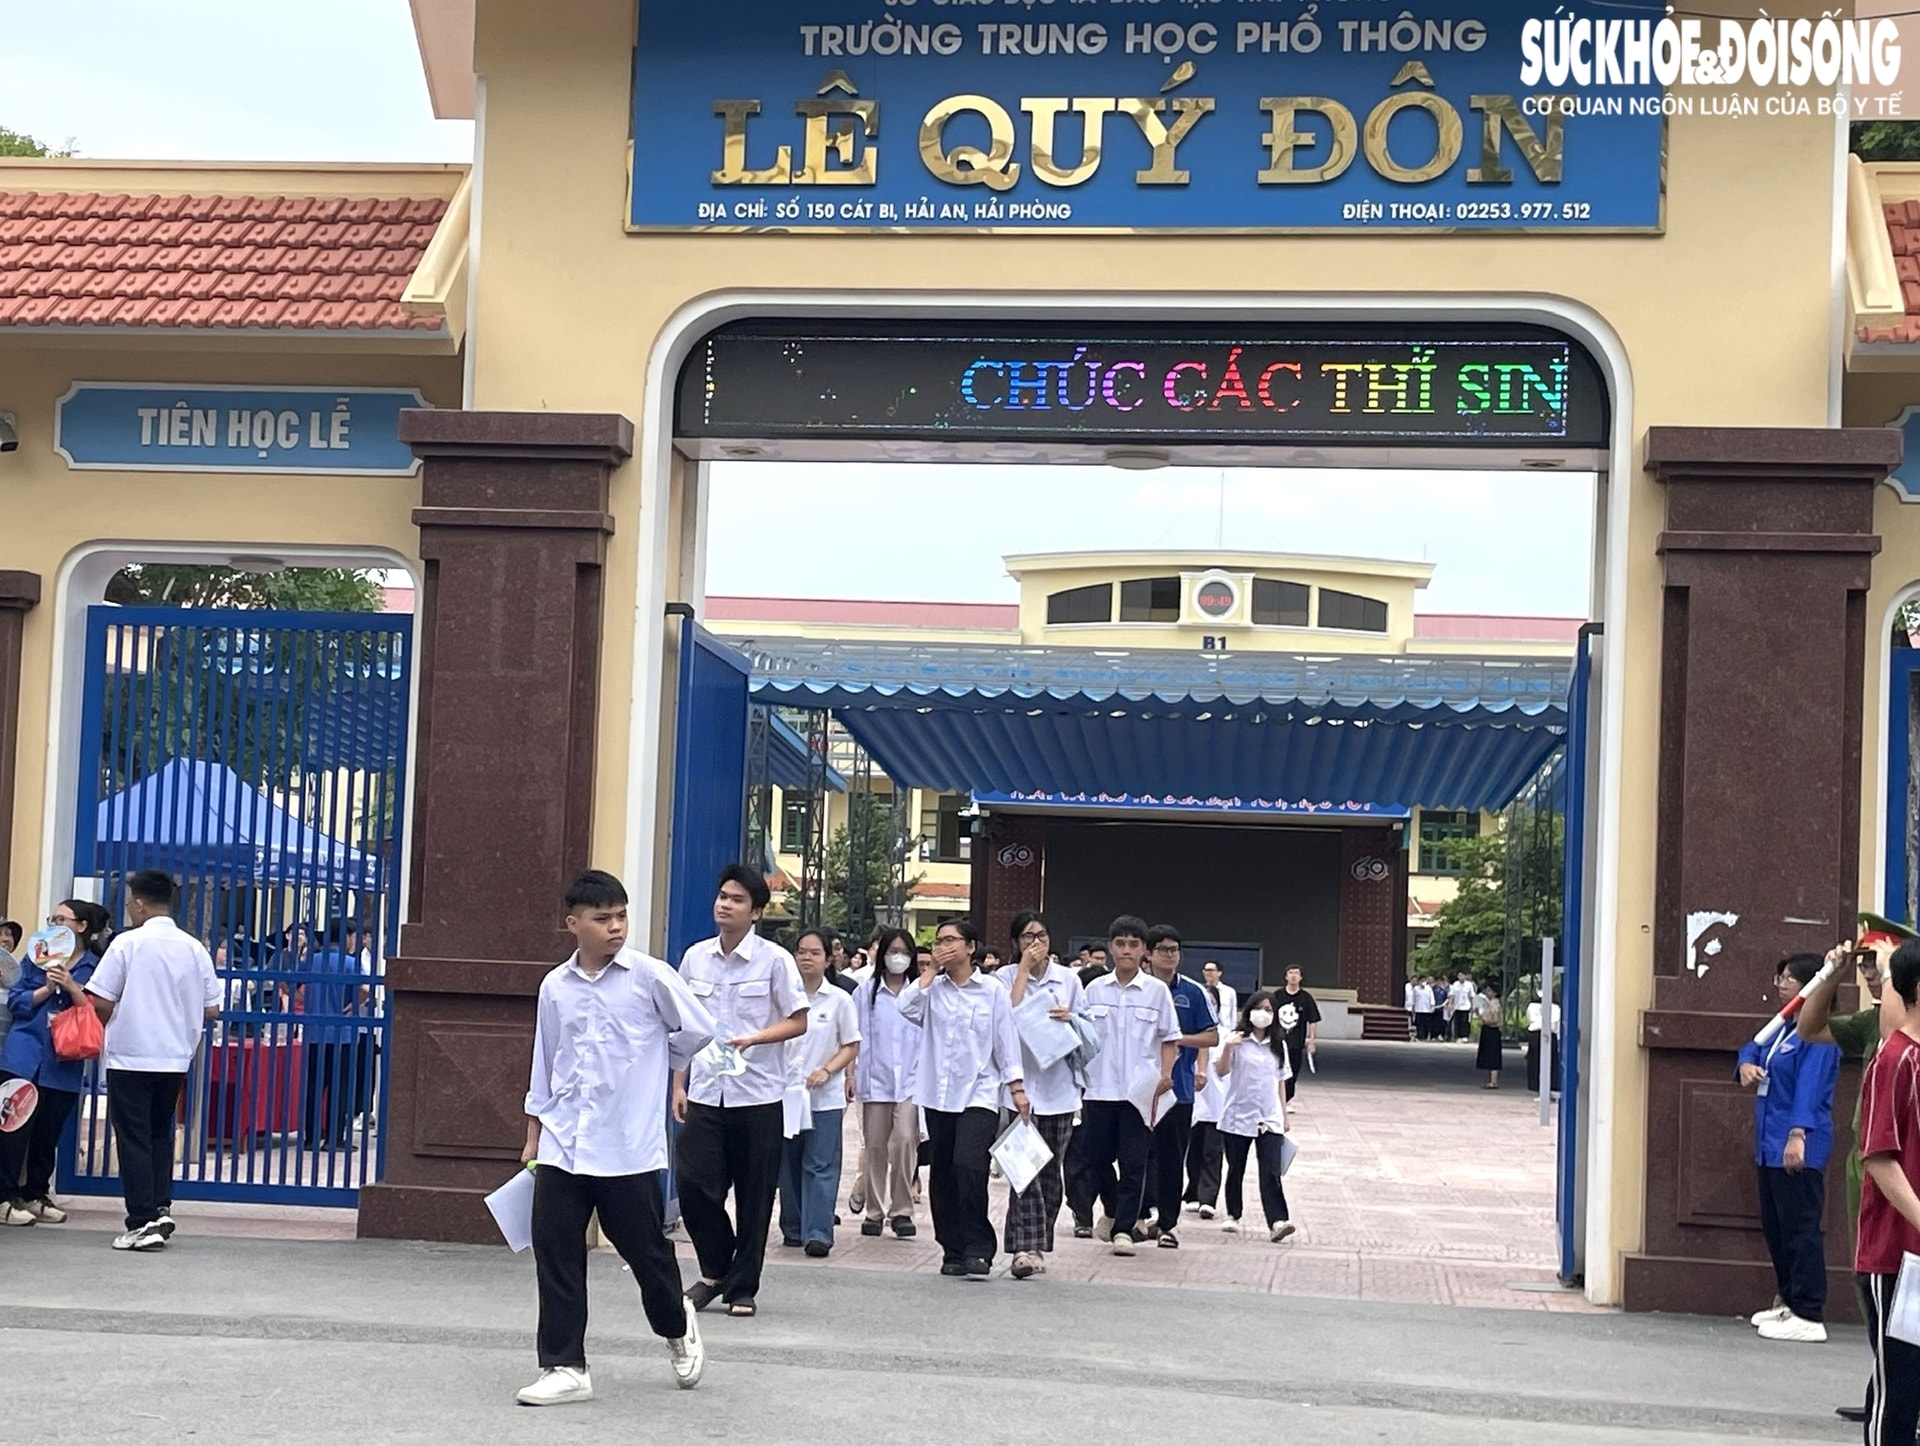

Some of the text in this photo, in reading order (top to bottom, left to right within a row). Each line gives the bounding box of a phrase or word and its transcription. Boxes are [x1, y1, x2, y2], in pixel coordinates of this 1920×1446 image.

[801, 4, 1487, 64] TRƯỜNG TRUNG HỌC PHỔ THÔNG
[711, 60, 1577, 191] LÊ QUÝ ĐÔN
[698, 195, 1072, 222] ĐỊA CHỈ: SỐ 150 CÁT BI, HẢI AN, HẢI PHÒNG
[1342, 199, 1383, 223] ĐIỆN
[1390, 203, 1451, 223] THOẠI:
[961, 346, 1146, 411] CHÚC
[1164, 347, 1302, 412] CÁC
[1456, 364, 1568, 414] SIN
[138, 397, 351, 459] TIÊN HỌC LỄ
[1202, 635, 1227, 651] B1
